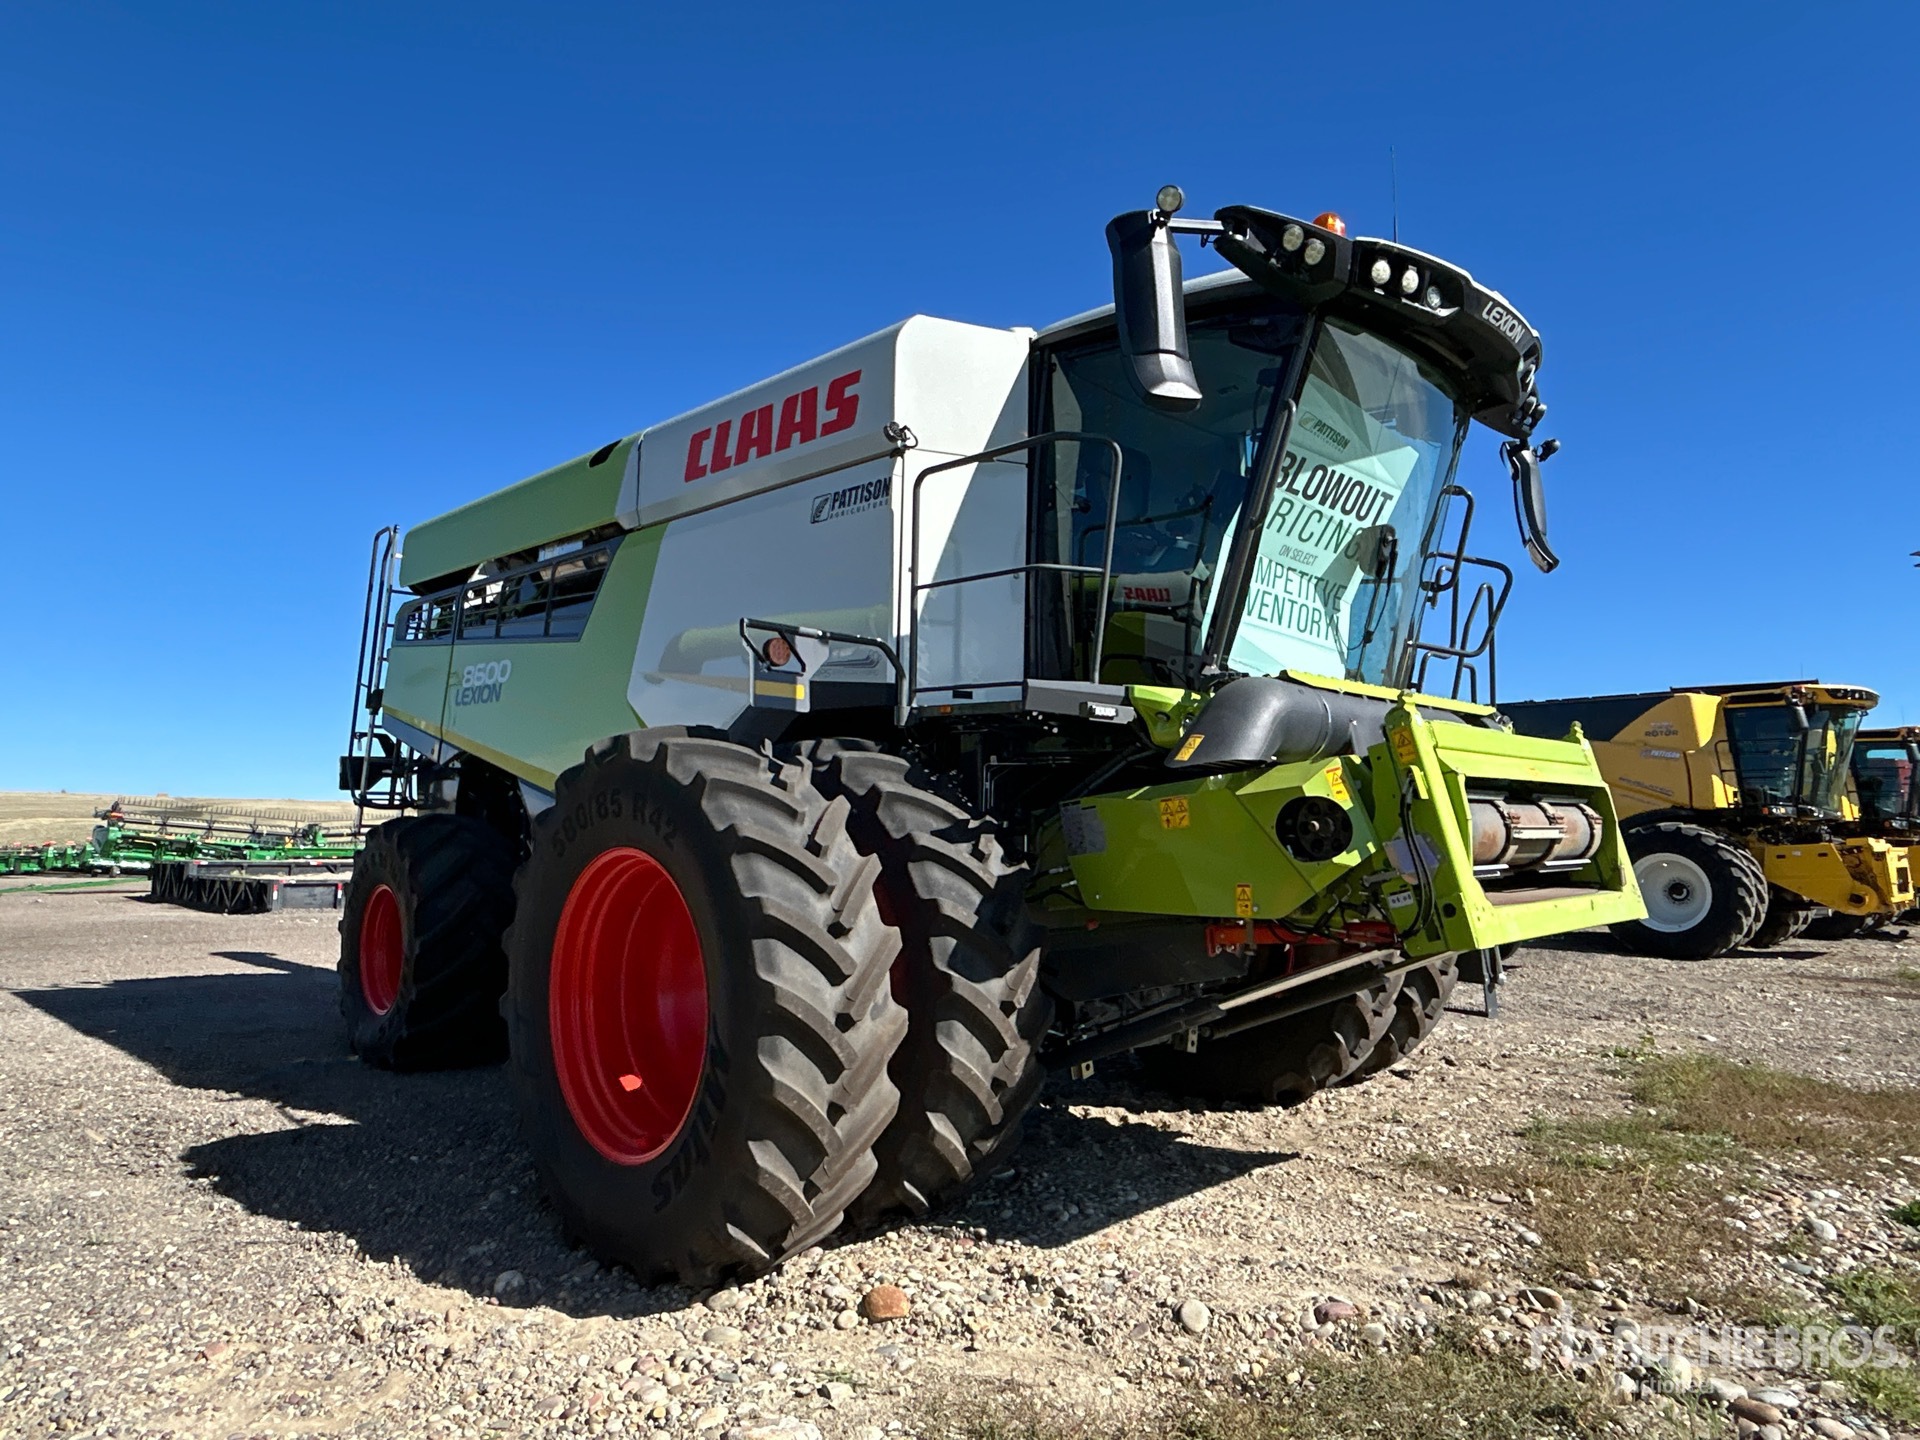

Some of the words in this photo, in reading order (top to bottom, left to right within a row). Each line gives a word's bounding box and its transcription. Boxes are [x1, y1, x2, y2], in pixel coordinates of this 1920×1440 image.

[1482, 301, 1525, 343] LEXION
[684, 369, 862, 483] CLAAS
[1313, 419, 1350, 450] PATTISON
[831, 477, 892, 511] PATTISON
[1276, 450, 1394, 527] BLOWOUT
[1266, 497, 1363, 560] RICING
[1278, 544, 1292, 558] ON
[1290, 548, 1319, 566] SELECT
[462, 659, 512, 688] 8600
[455, 682, 503, 706] LEXION
